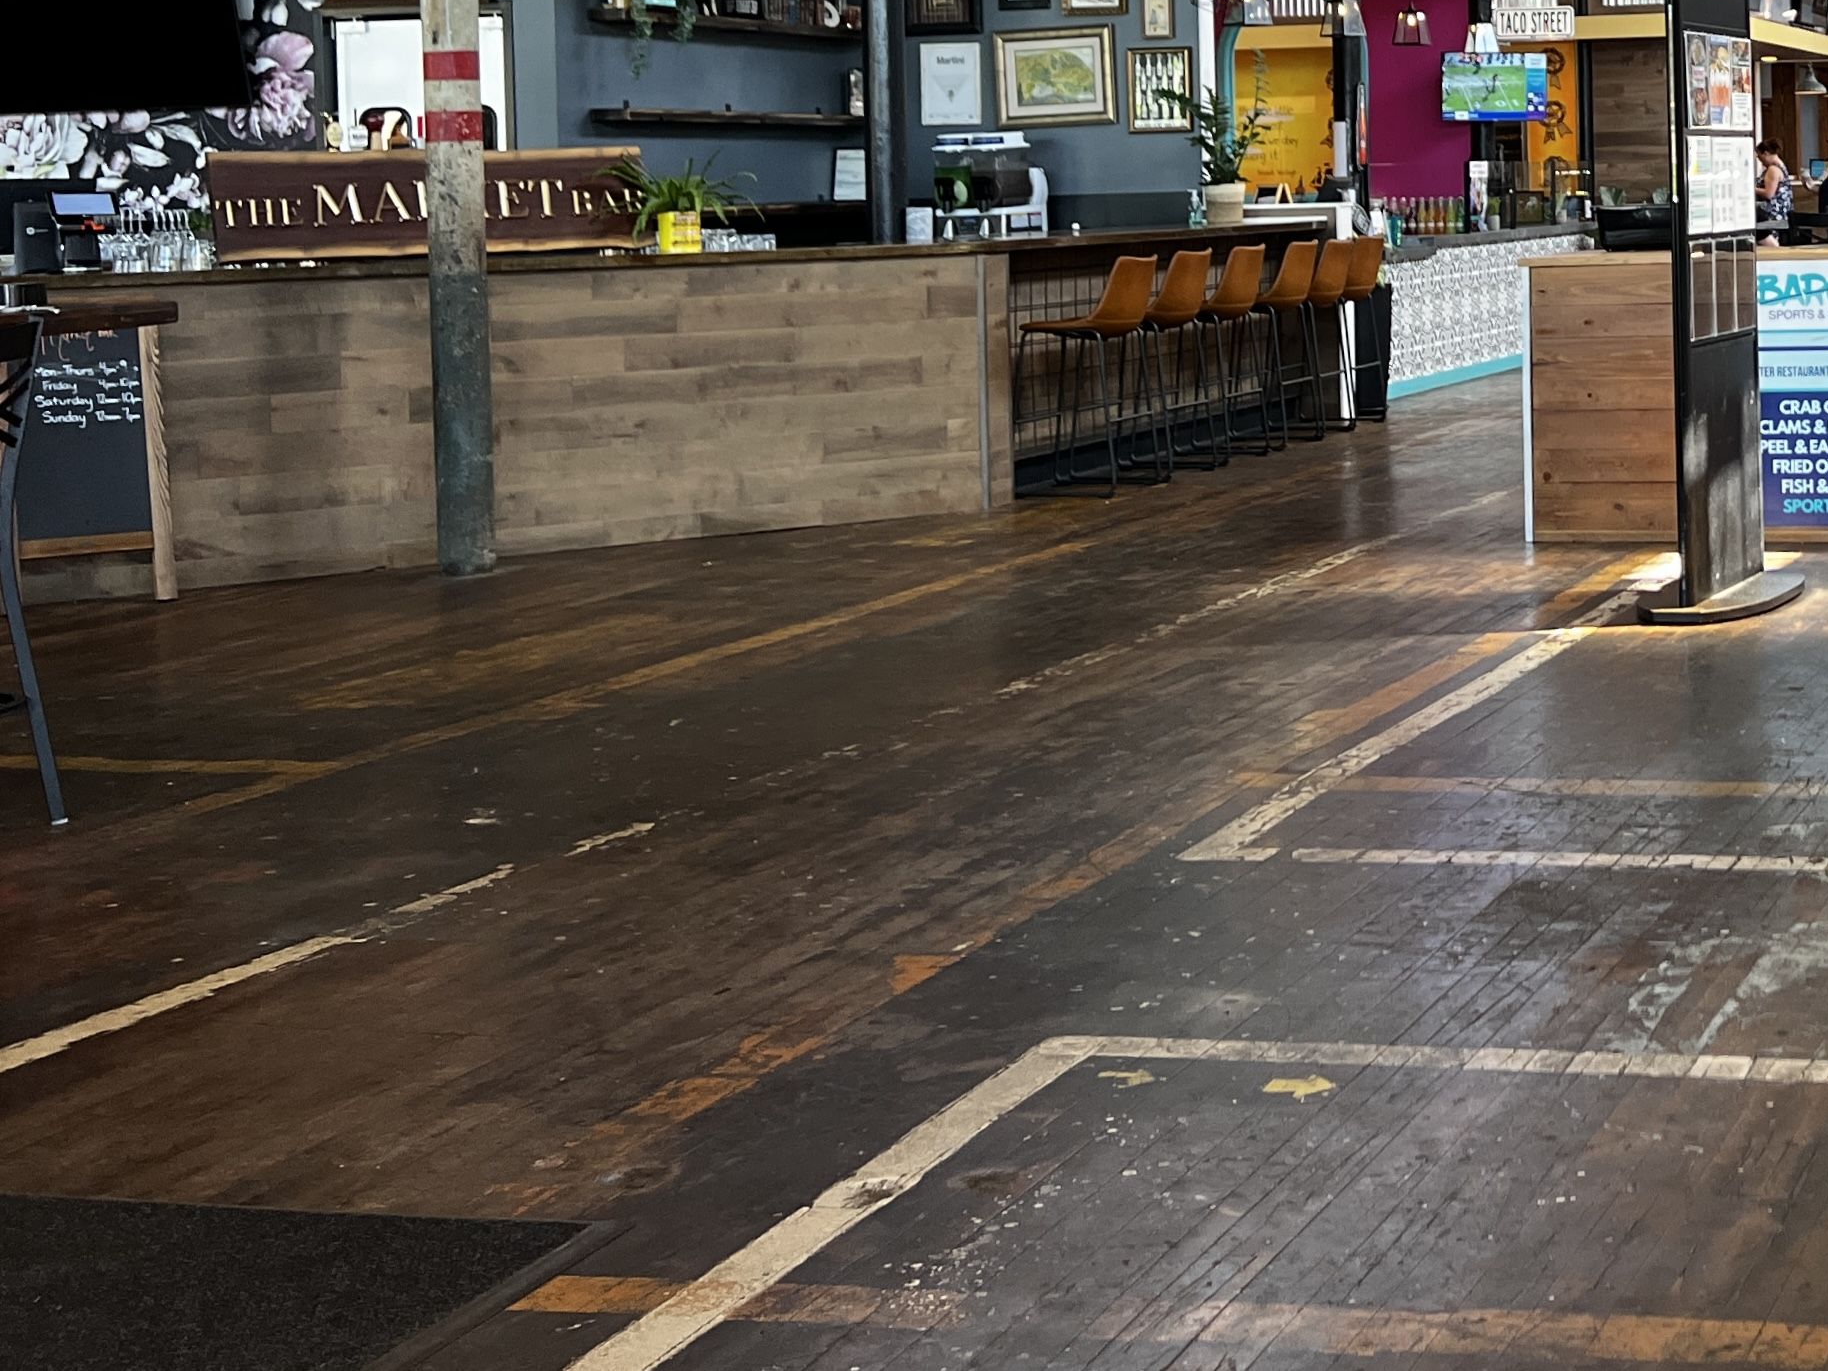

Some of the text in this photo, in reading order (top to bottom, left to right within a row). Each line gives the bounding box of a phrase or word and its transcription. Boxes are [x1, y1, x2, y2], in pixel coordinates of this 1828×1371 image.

[1500, 11, 1568, 34] TACO STREET
[936, 56, 965, 65] Martini
[214, 198, 303, 228] THE
[312, 179, 564, 228] MAET
[1768, 308, 1815, 320] SPORTS
[1817, 308, 1825, 319] &
[1760, 366, 1775, 377] TER
[1777, 366, 1828, 377] RESTAURANT
[42, 380, 78, 395] Friday
[34, 395, 94, 413] Saturday
[1779, 399, 1821, 414] CRAB
[41, 410, 87, 429] Sunday
[1759, 419, 1811, 434] CLAMS
[1813, 419, 1827, 434] &
[1760, 440, 1793, 454] PEEL
[1794, 439, 1808, 454] &
[1772, 459, 1814, 474] FRIED
[1781, 479, 1814, 494] FISH
